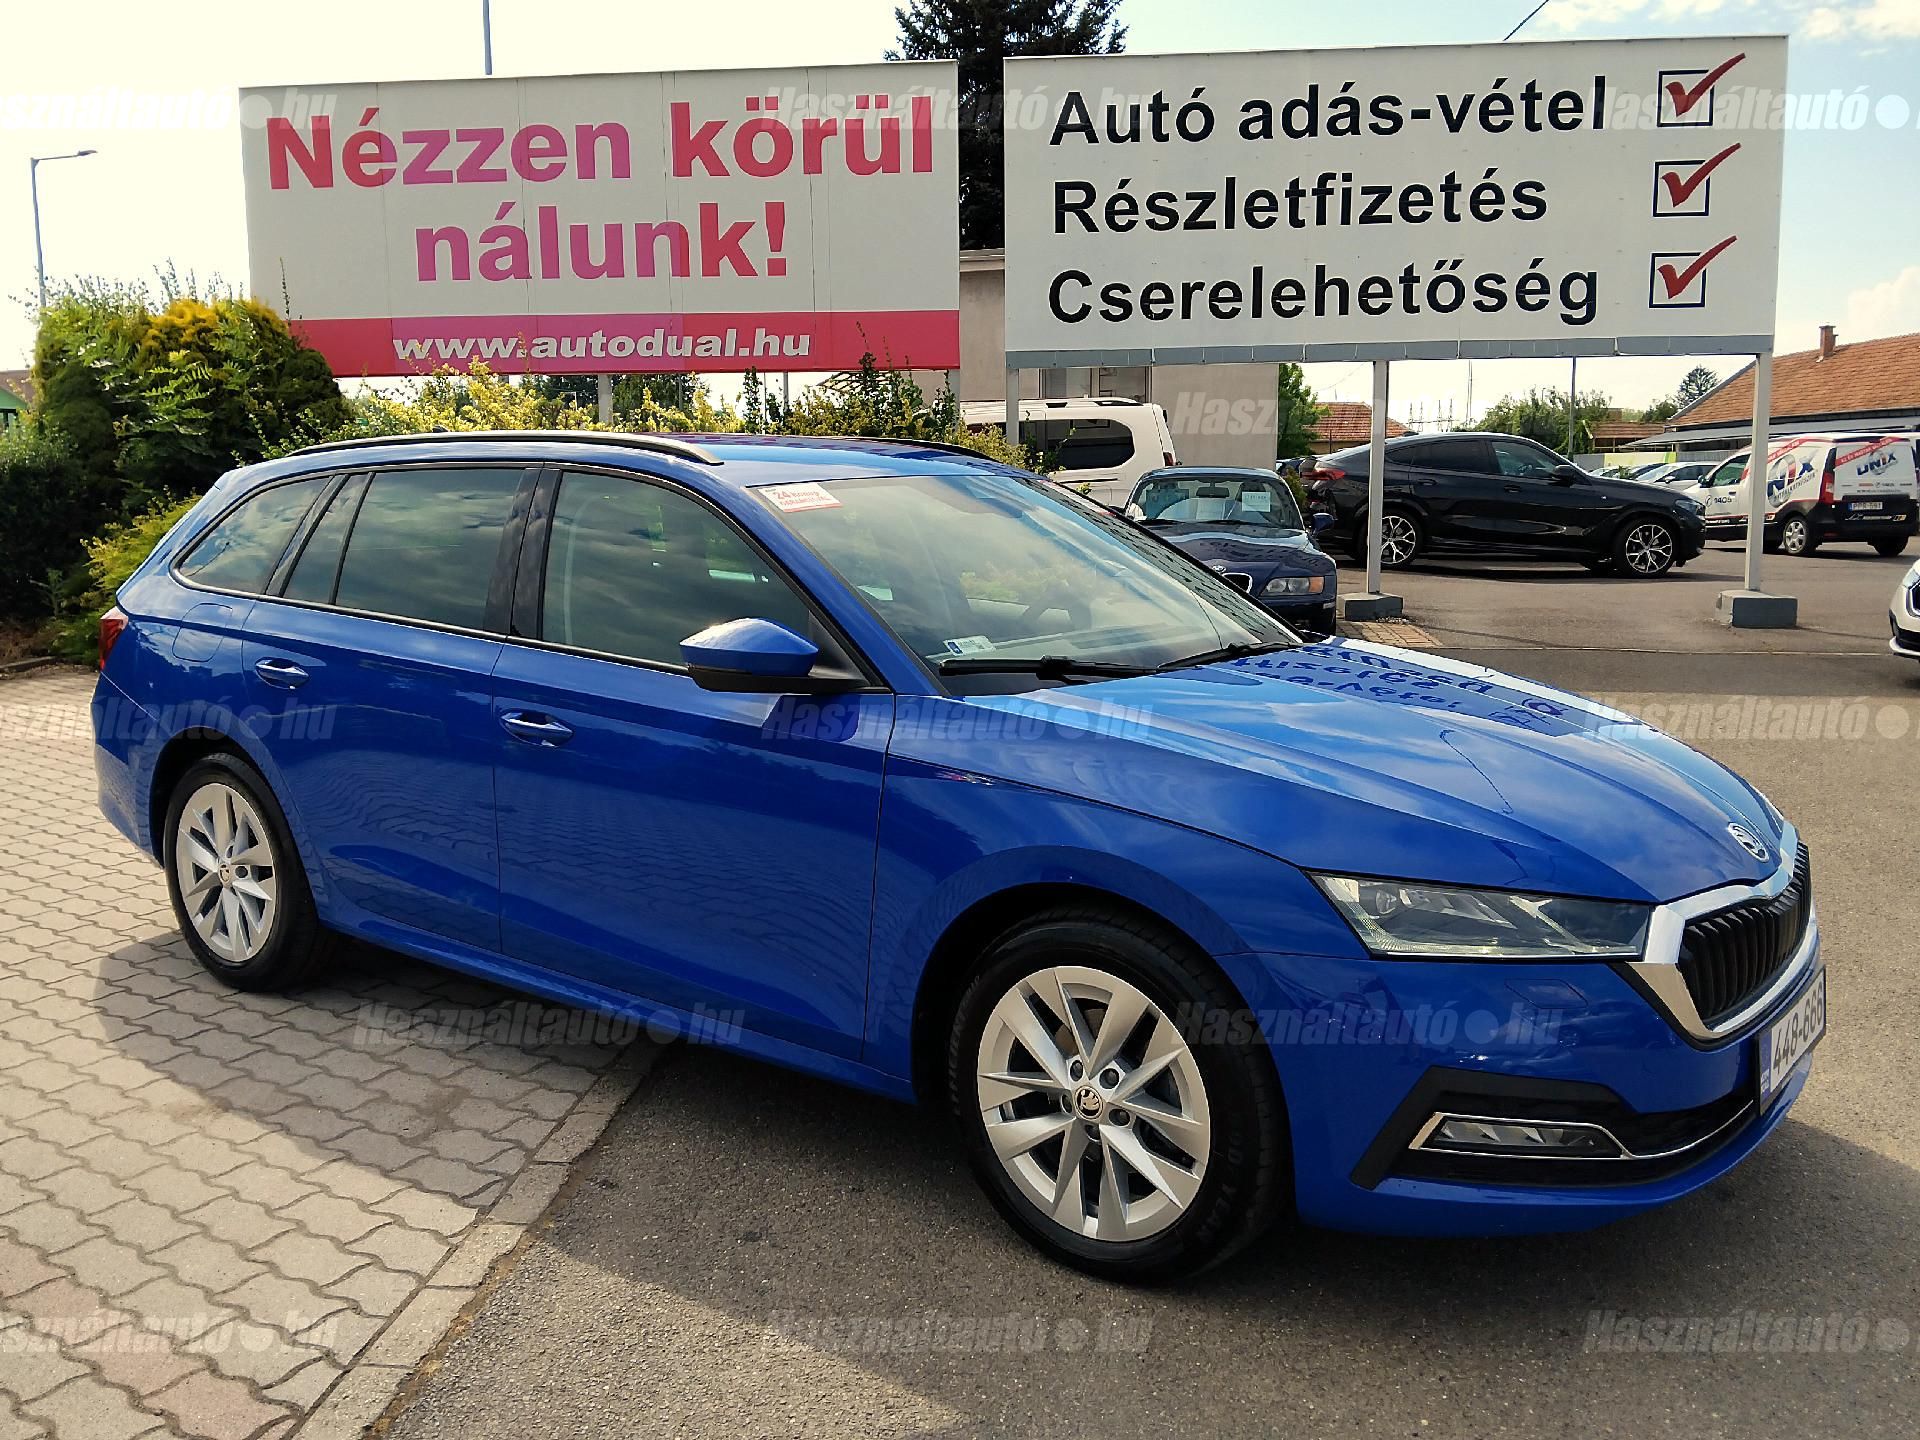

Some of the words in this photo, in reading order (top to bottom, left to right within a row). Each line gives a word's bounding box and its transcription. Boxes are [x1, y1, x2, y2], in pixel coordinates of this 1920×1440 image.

[267, 108, 631, 190] Nézzen
[671, 95, 933, 178] körül
[1050, 87, 1215, 146] Autó
[1238, 75, 1606, 141] adás-vétel
[1054, 167, 1547, 234] Részletfizetés
[416, 201, 787, 281] nálunk!
[1048, 257, 1597, 326] Cserelehetőség
[392, 327, 810, 360] www.autodual.hu
[1773, 981, 1823, 1075] 448-666
